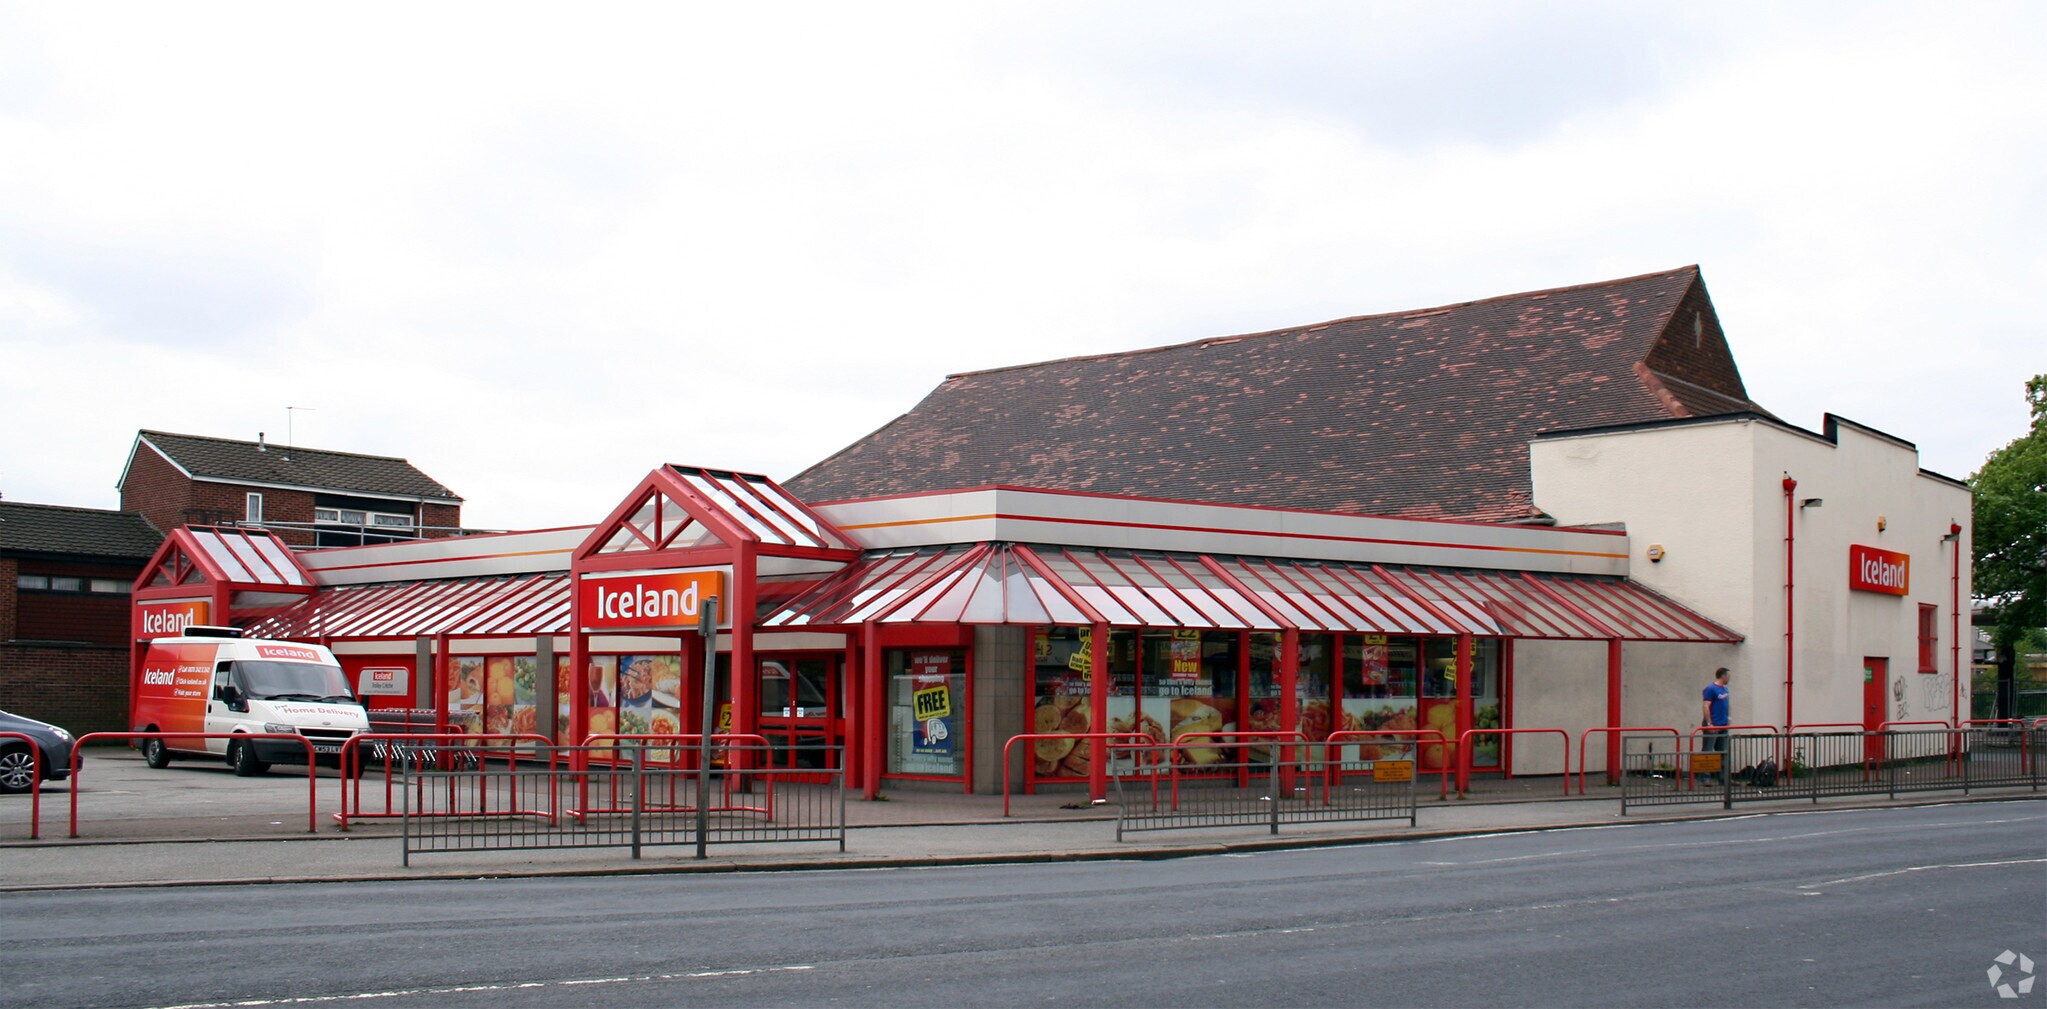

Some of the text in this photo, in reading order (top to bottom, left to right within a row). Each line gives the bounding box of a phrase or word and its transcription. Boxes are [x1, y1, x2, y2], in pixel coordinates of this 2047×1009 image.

[1861, 552, 1905, 589] Iceland
[597, 581, 698, 619] Iceland
[143, 608, 194, 633] Iceland
[264, 648, 315, 659] Iceland
[1174, 660, 1197, 672] New
[144, 668, 175, 685] Iceland
[374, 671, 392, 680] Iceland
[1159, 685, 1213, 696] go to Iceland
[918, 690, 946, 715] FREE
[283, 706, 359, 718] Home Delivery
